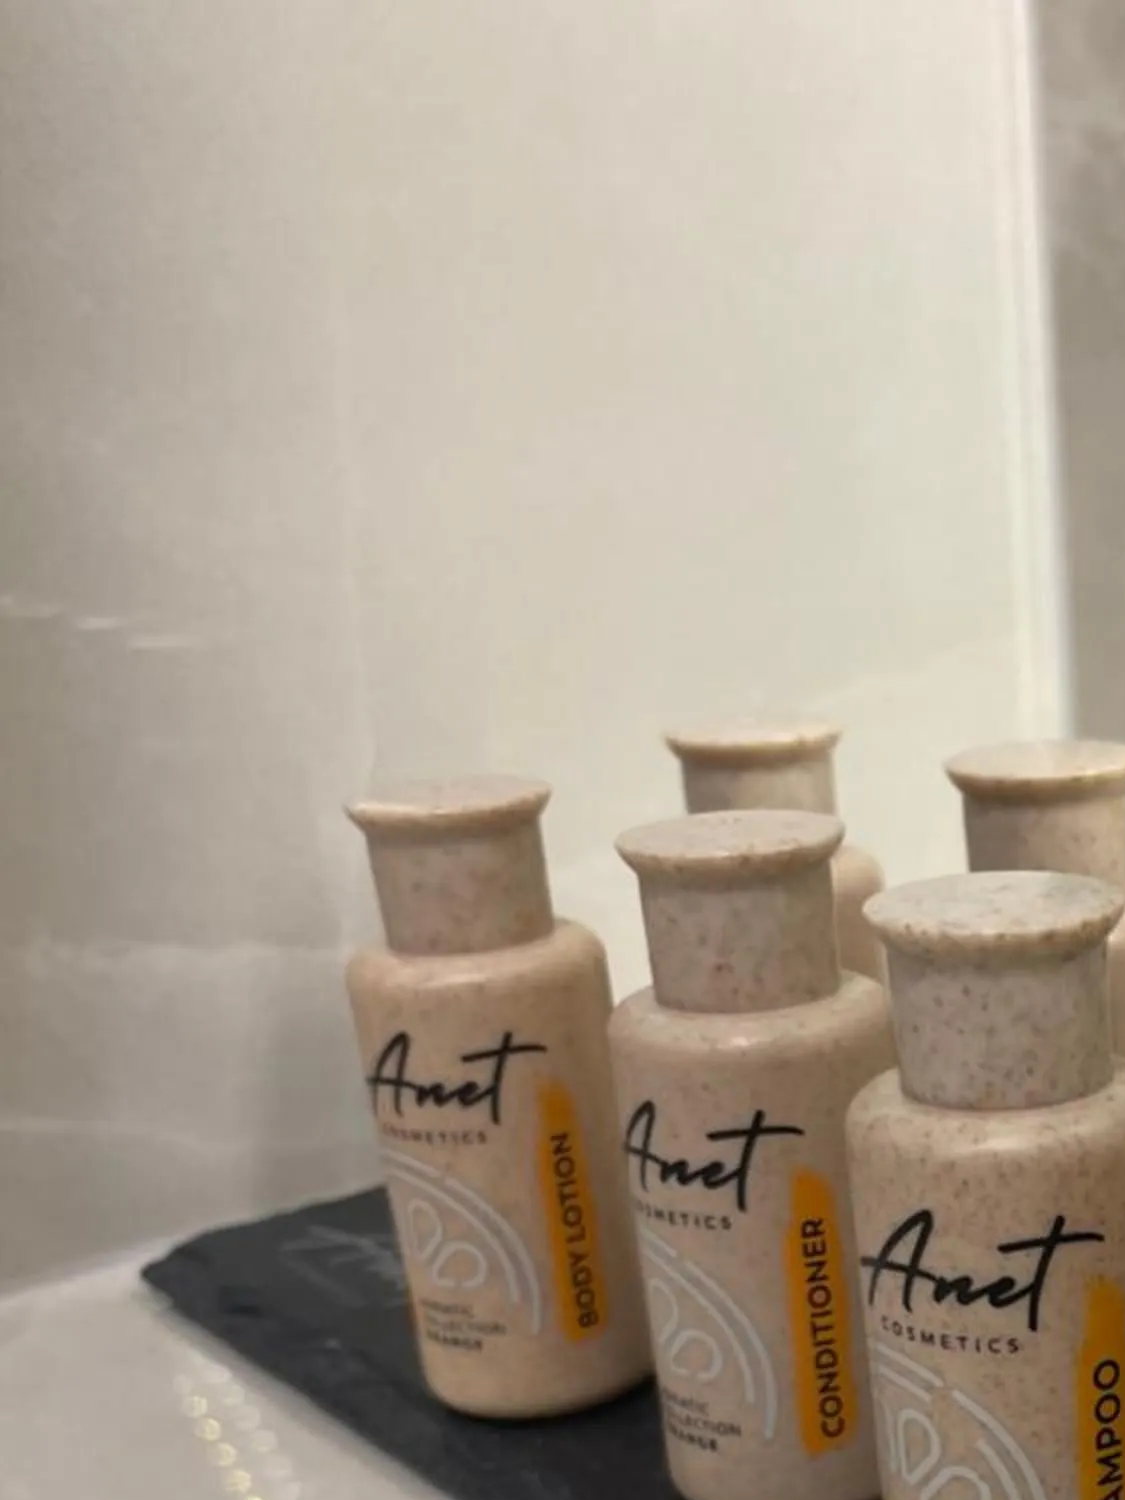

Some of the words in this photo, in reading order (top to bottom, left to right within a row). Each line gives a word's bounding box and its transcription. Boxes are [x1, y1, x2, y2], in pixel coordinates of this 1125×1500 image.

[366, 1032, 547, 1125] Anet
[551, 1131, 587, 1241] LOTION
[624, 1100, 805, 1212] Anet
[571, 1250, 599, 1329] BODY
[861, 1209, 1105, 1332] Anet
[799, 1218, 845, 1438] CONDITIONER
[880, 1316, 1020, 1355] COSMETICS
